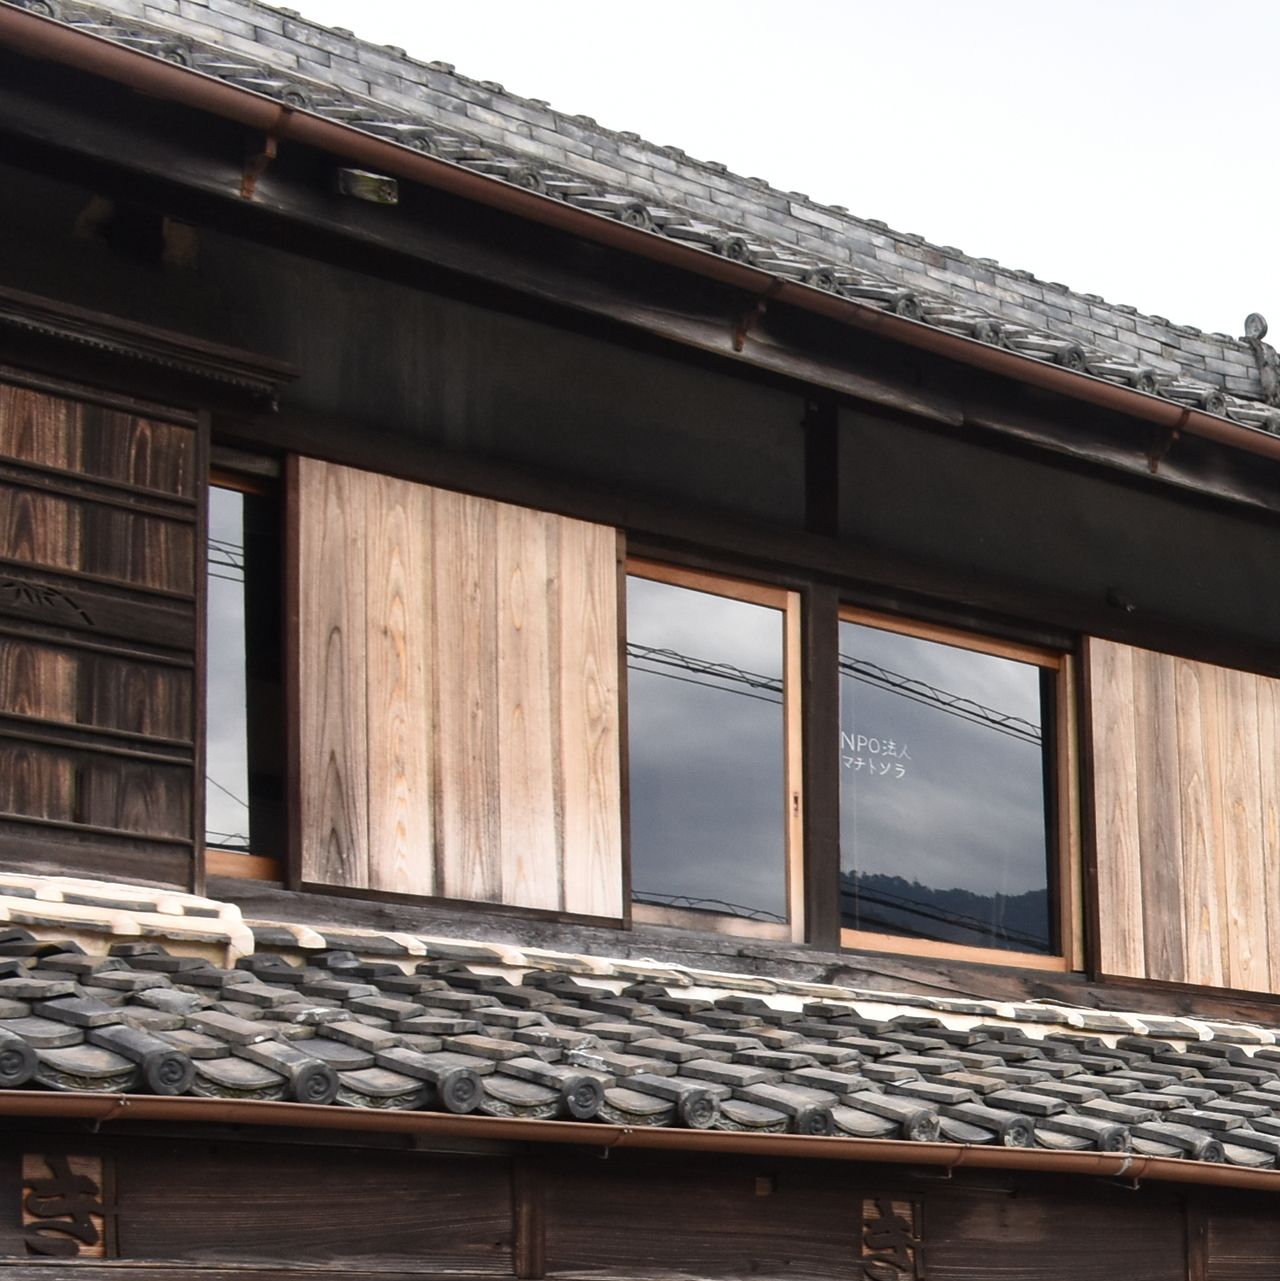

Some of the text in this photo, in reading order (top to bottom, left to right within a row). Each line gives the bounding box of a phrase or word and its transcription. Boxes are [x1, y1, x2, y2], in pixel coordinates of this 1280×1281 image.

[841, 731, 911, 760] NPO法人
[842, 755, 906, 778] マチトソラ
